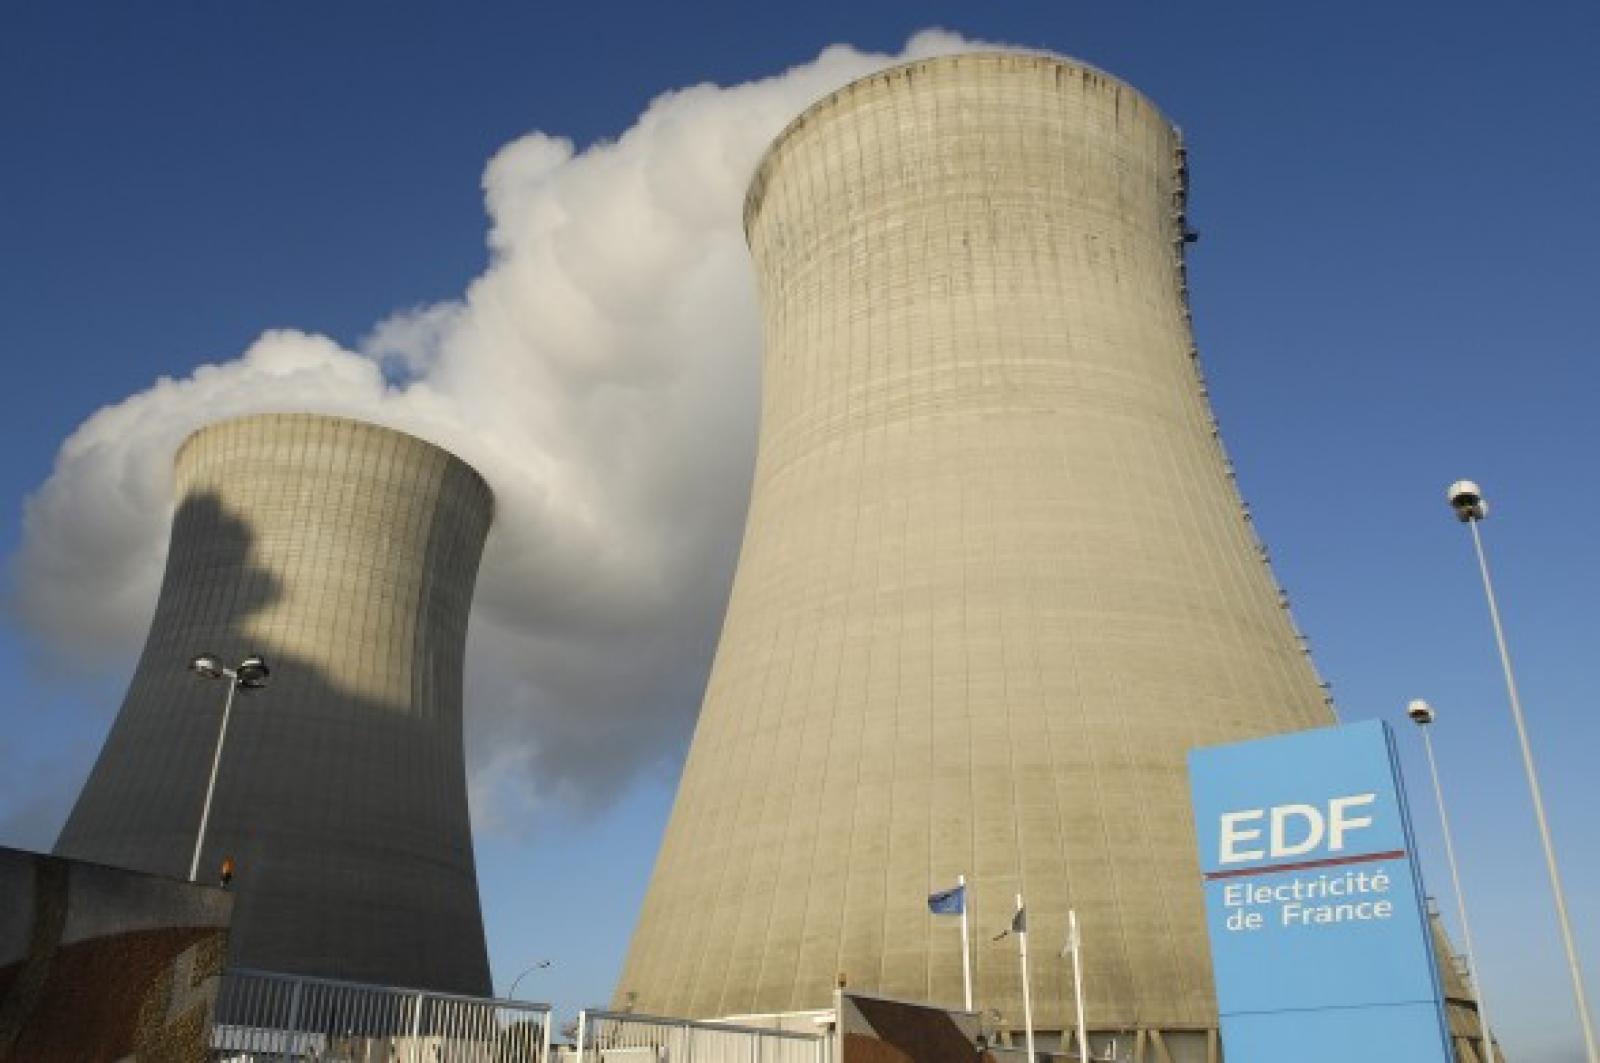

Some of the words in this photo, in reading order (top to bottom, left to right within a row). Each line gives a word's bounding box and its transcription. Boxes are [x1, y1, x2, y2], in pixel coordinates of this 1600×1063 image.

[1219, 793, 1376, 864] EDF
[1223, 870, 1391, 906] Electricité
[1226, 908, 1264, 931] de
[1282, 900, 1392, 927] France
